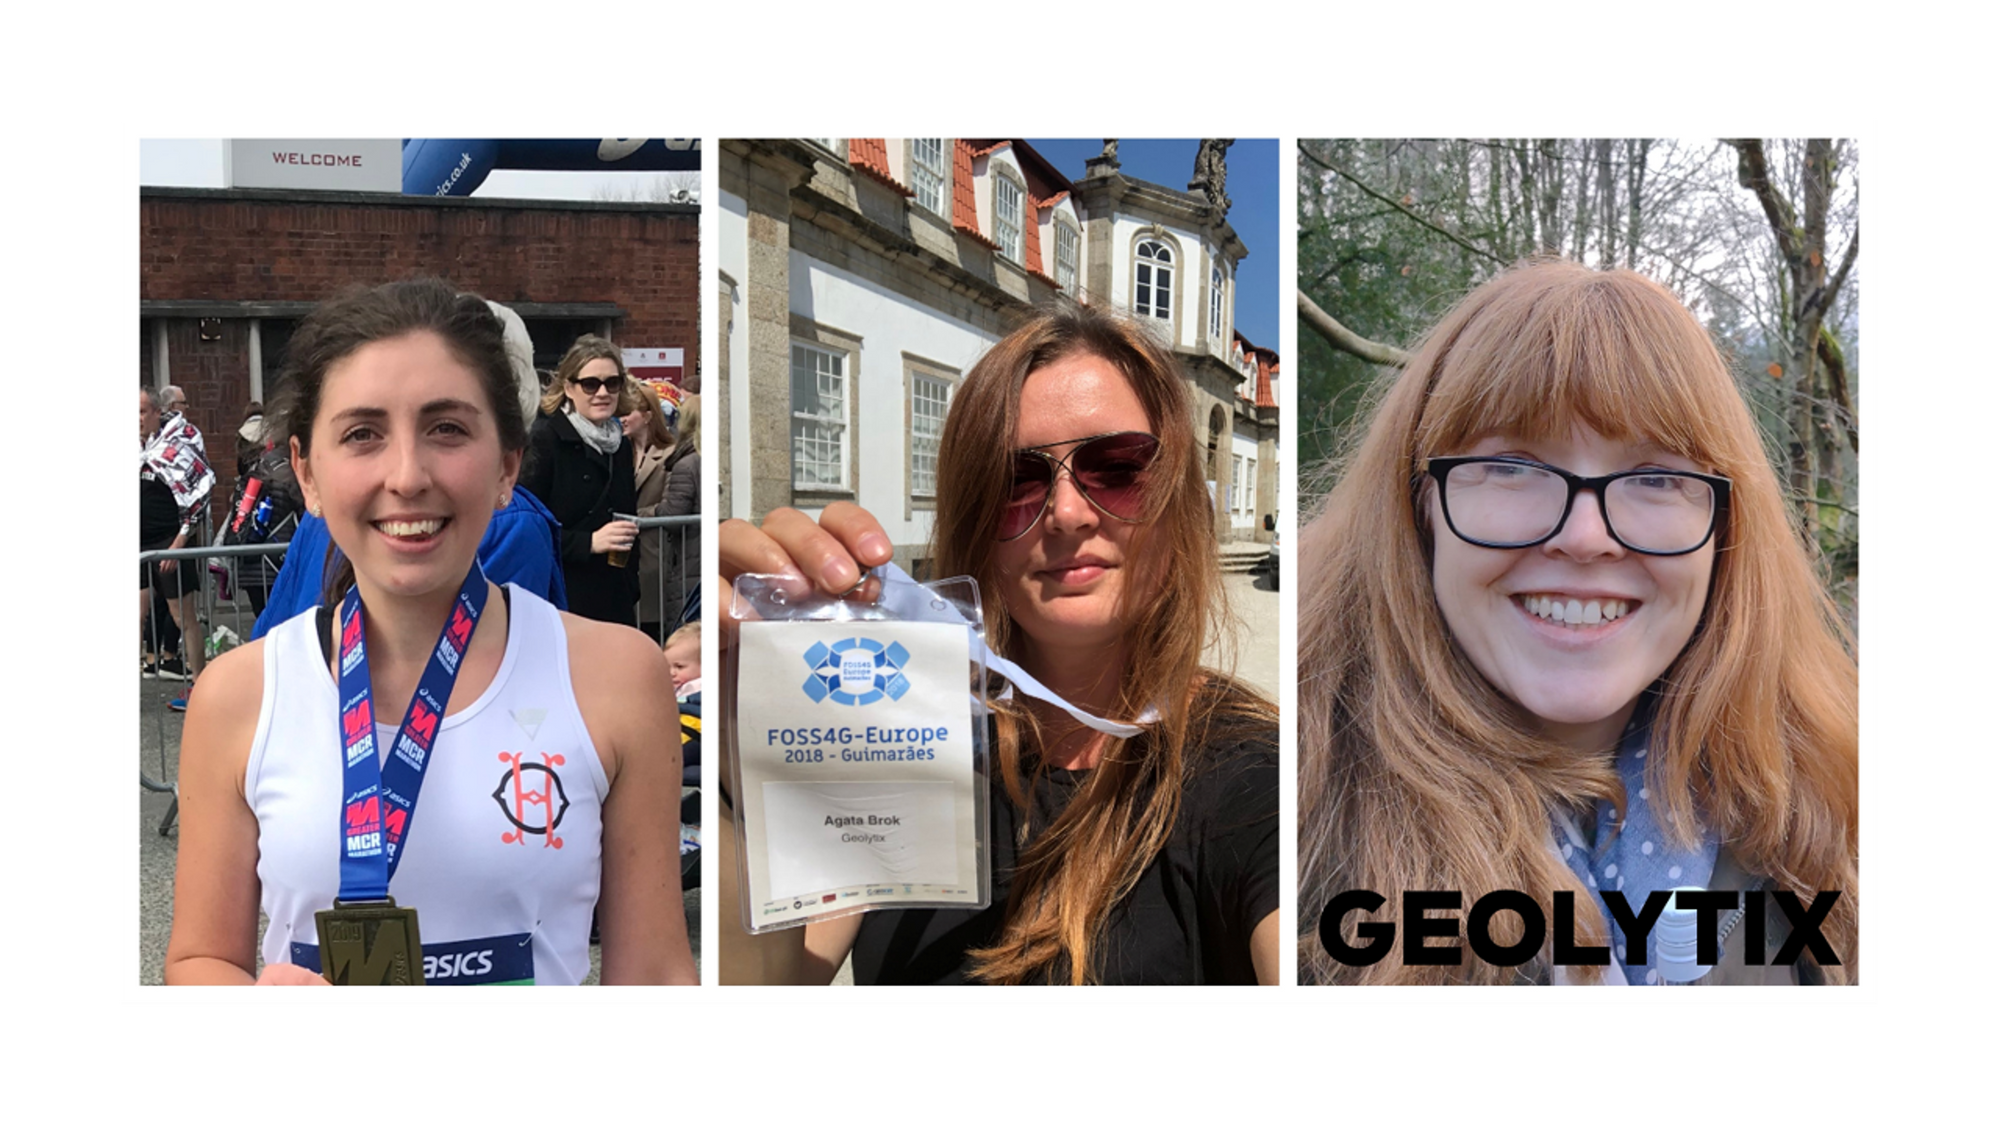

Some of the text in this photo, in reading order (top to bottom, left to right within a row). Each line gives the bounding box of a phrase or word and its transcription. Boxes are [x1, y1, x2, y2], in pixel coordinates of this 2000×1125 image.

[272, 151, 362, 167] WELCOME
[767, 726, 949, 746] FOSS4G-Europe
[347, 734, 373, 761] MCR
[398, 733, 426, 764] MCR
[785, 749, 824, 763] 2018
[841, 746, 935, 762] Guimarães
[824, 815, 901, 828] Agata Brok
[347, 832, 381, 851] MCR
[841, 833, 886, 844] Geolytix
